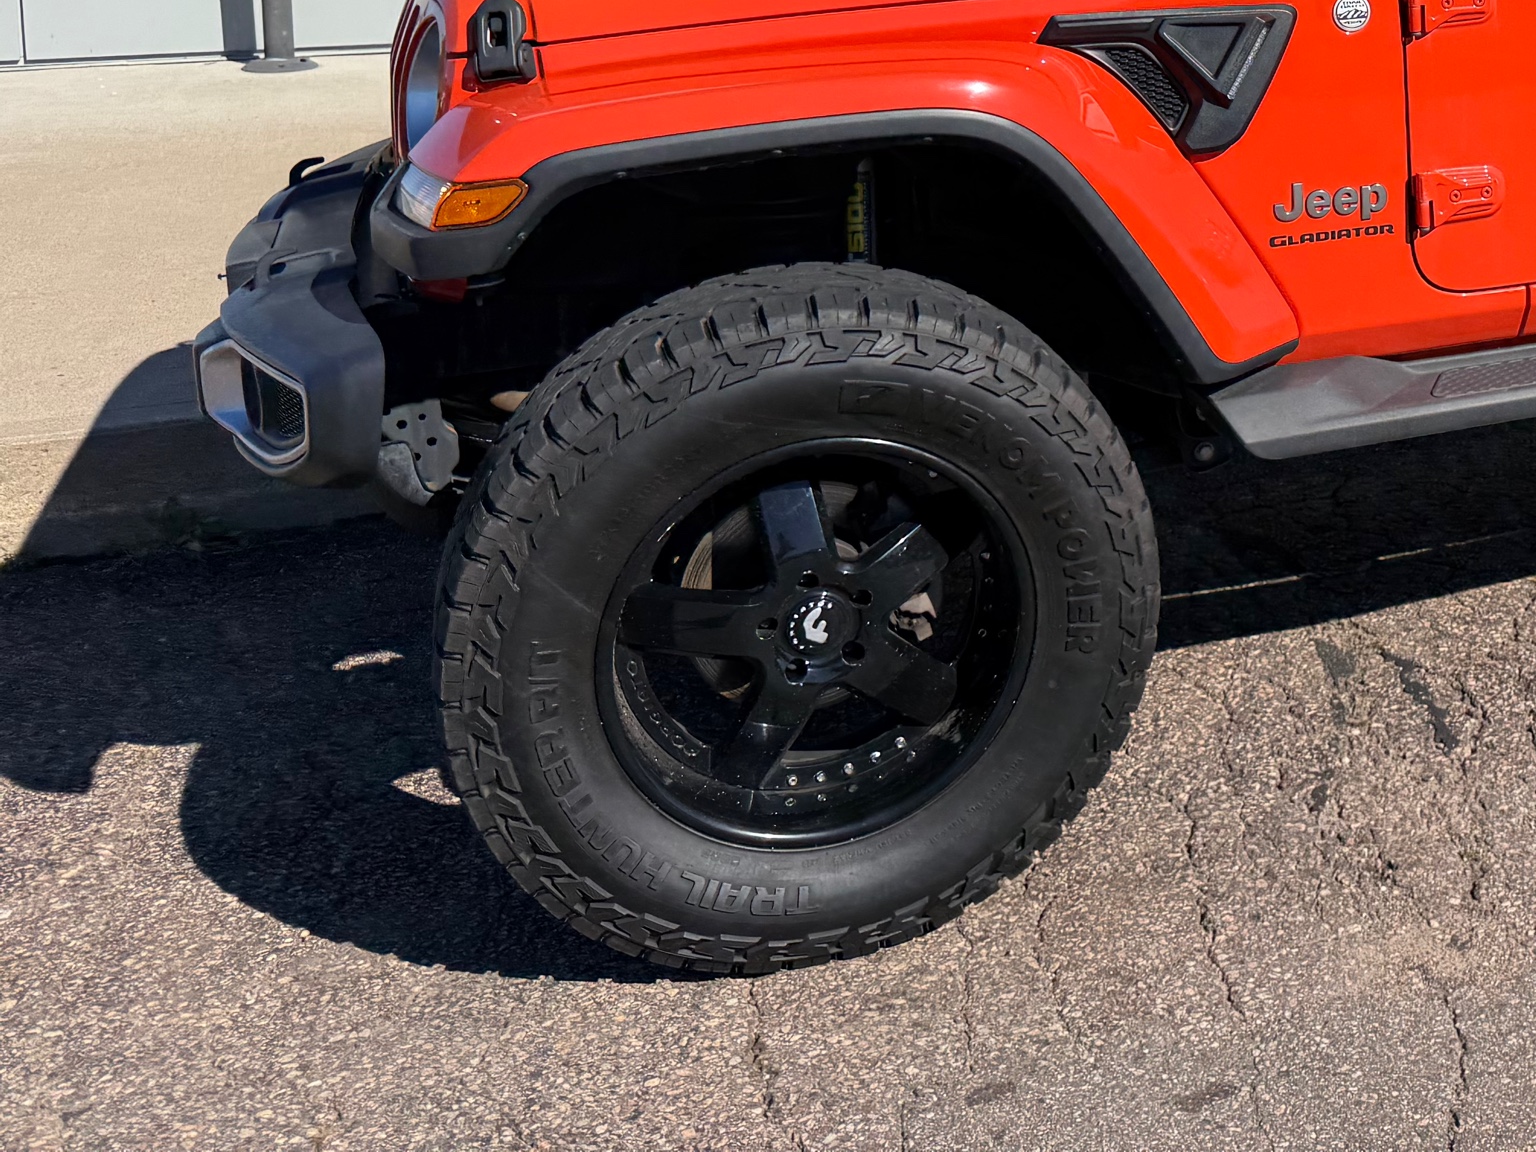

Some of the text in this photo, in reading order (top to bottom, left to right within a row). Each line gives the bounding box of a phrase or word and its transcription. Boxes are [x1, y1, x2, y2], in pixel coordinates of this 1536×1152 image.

[1273, 182, 1388, 222] Jeep
[1269, 224, 1394, 248] GLADIATOR
[1042, 498, 1105, 656] POWER
[534, 727, 673, 891] HUNTER
[681, 870, 820, 917] TRAIL
